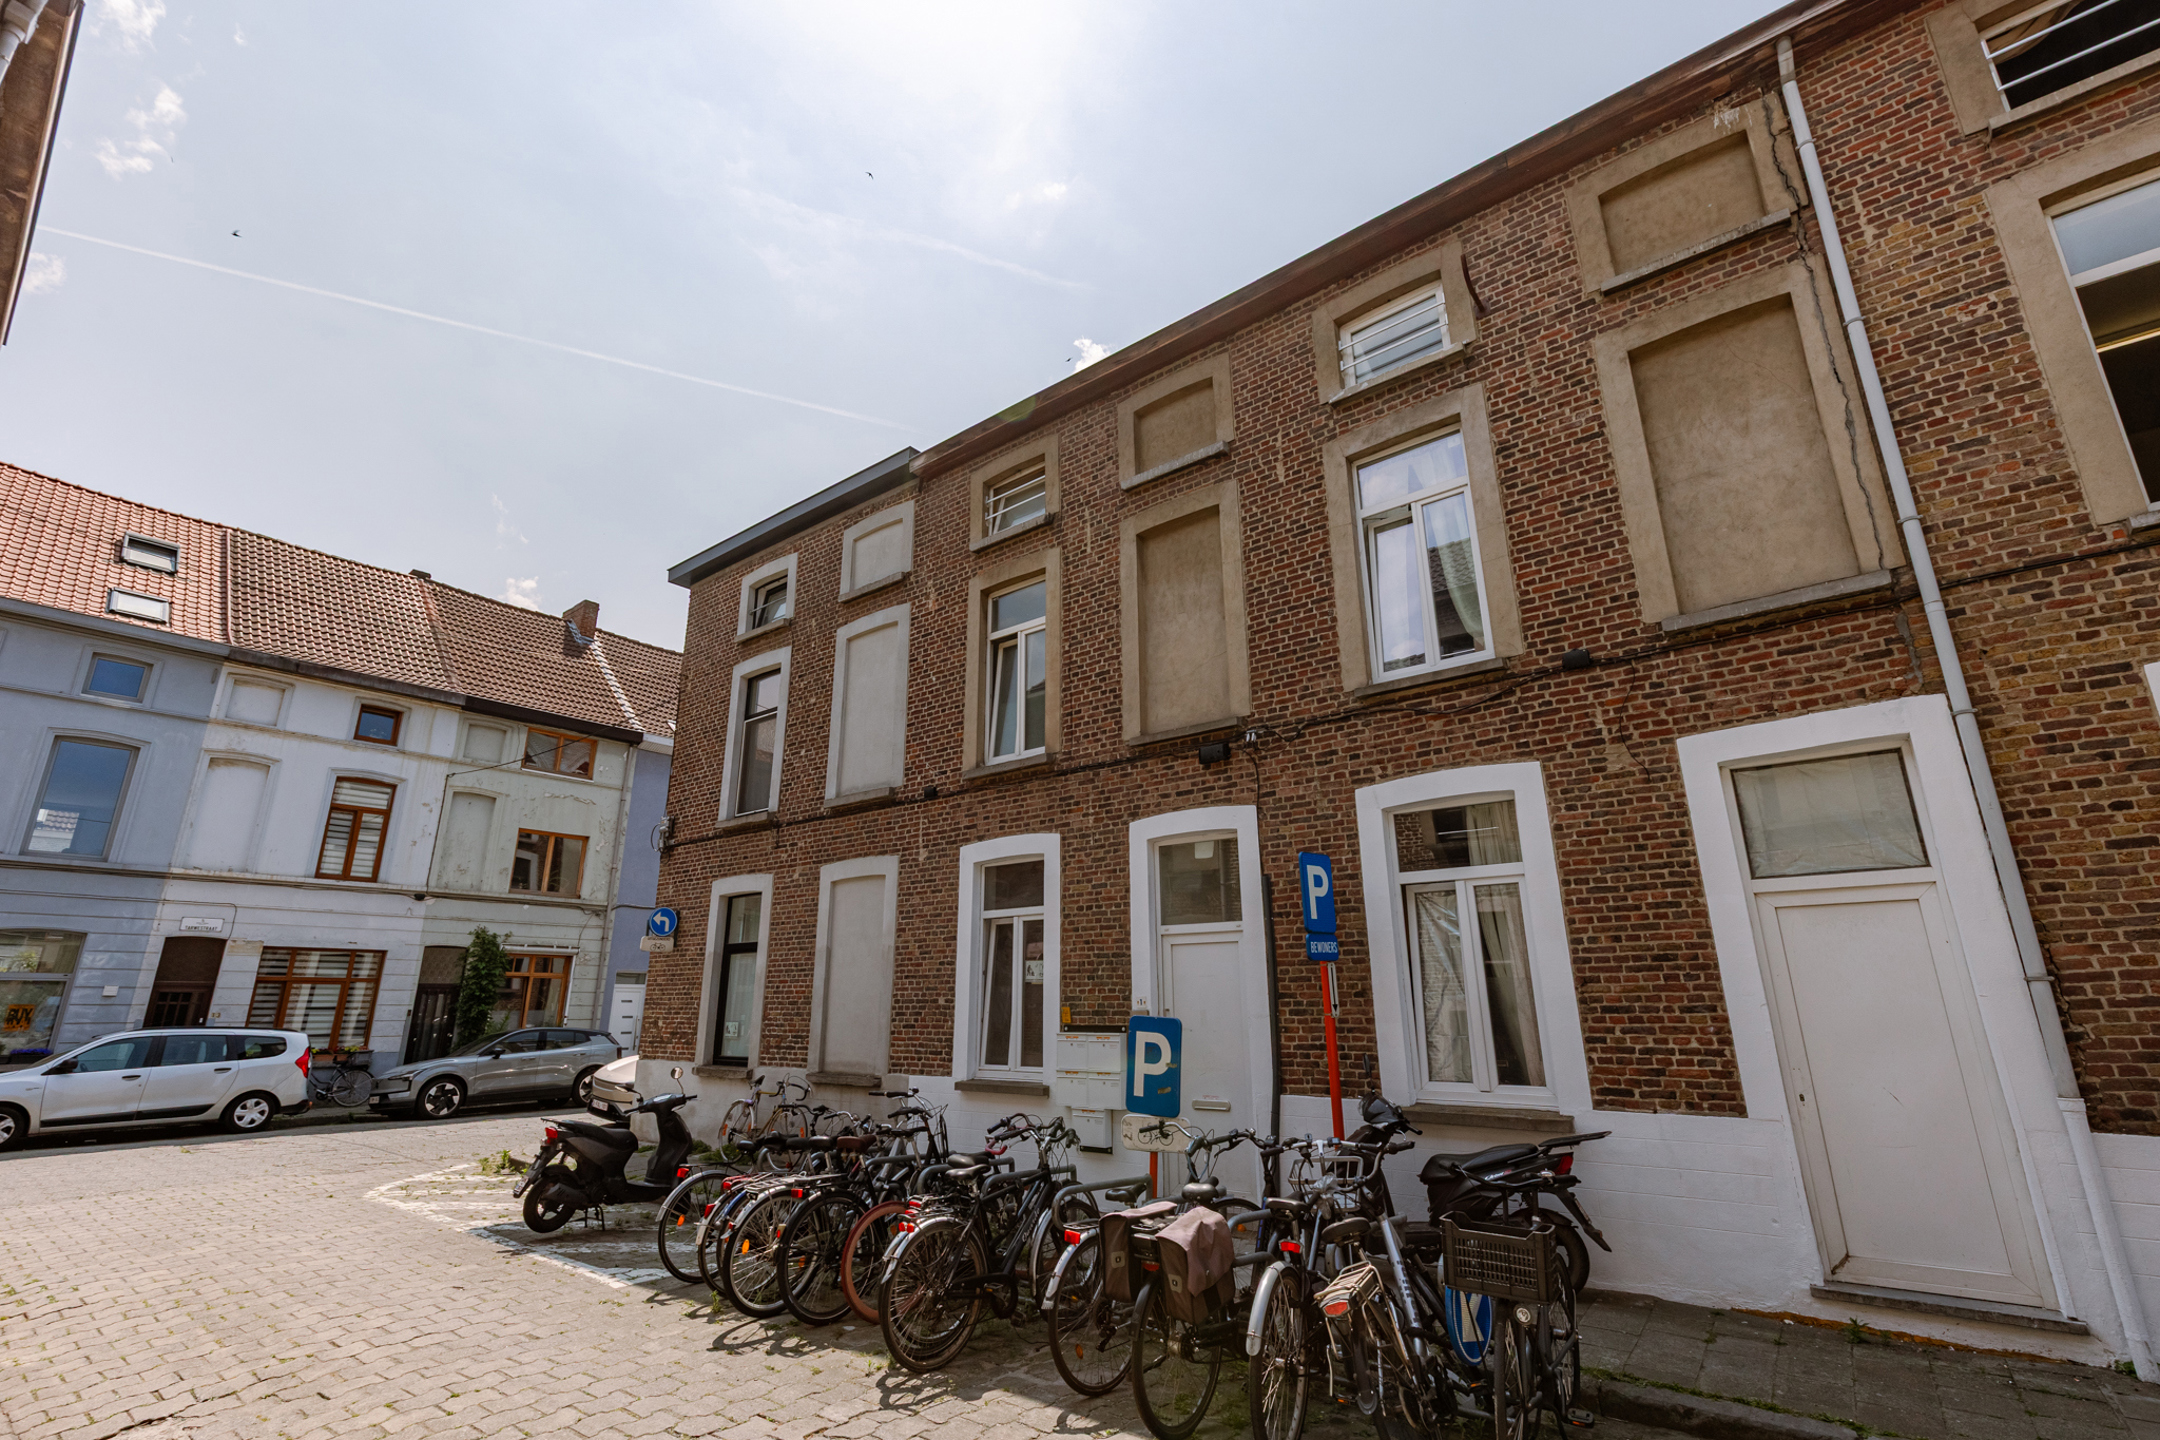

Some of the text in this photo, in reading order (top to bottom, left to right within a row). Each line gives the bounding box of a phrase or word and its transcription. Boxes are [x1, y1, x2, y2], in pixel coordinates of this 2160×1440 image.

[1306, 864, 1329, 920] P
[1310, 941, 1338, 954] BEWONERS
[1133, 1030, 1172, 1097] P
